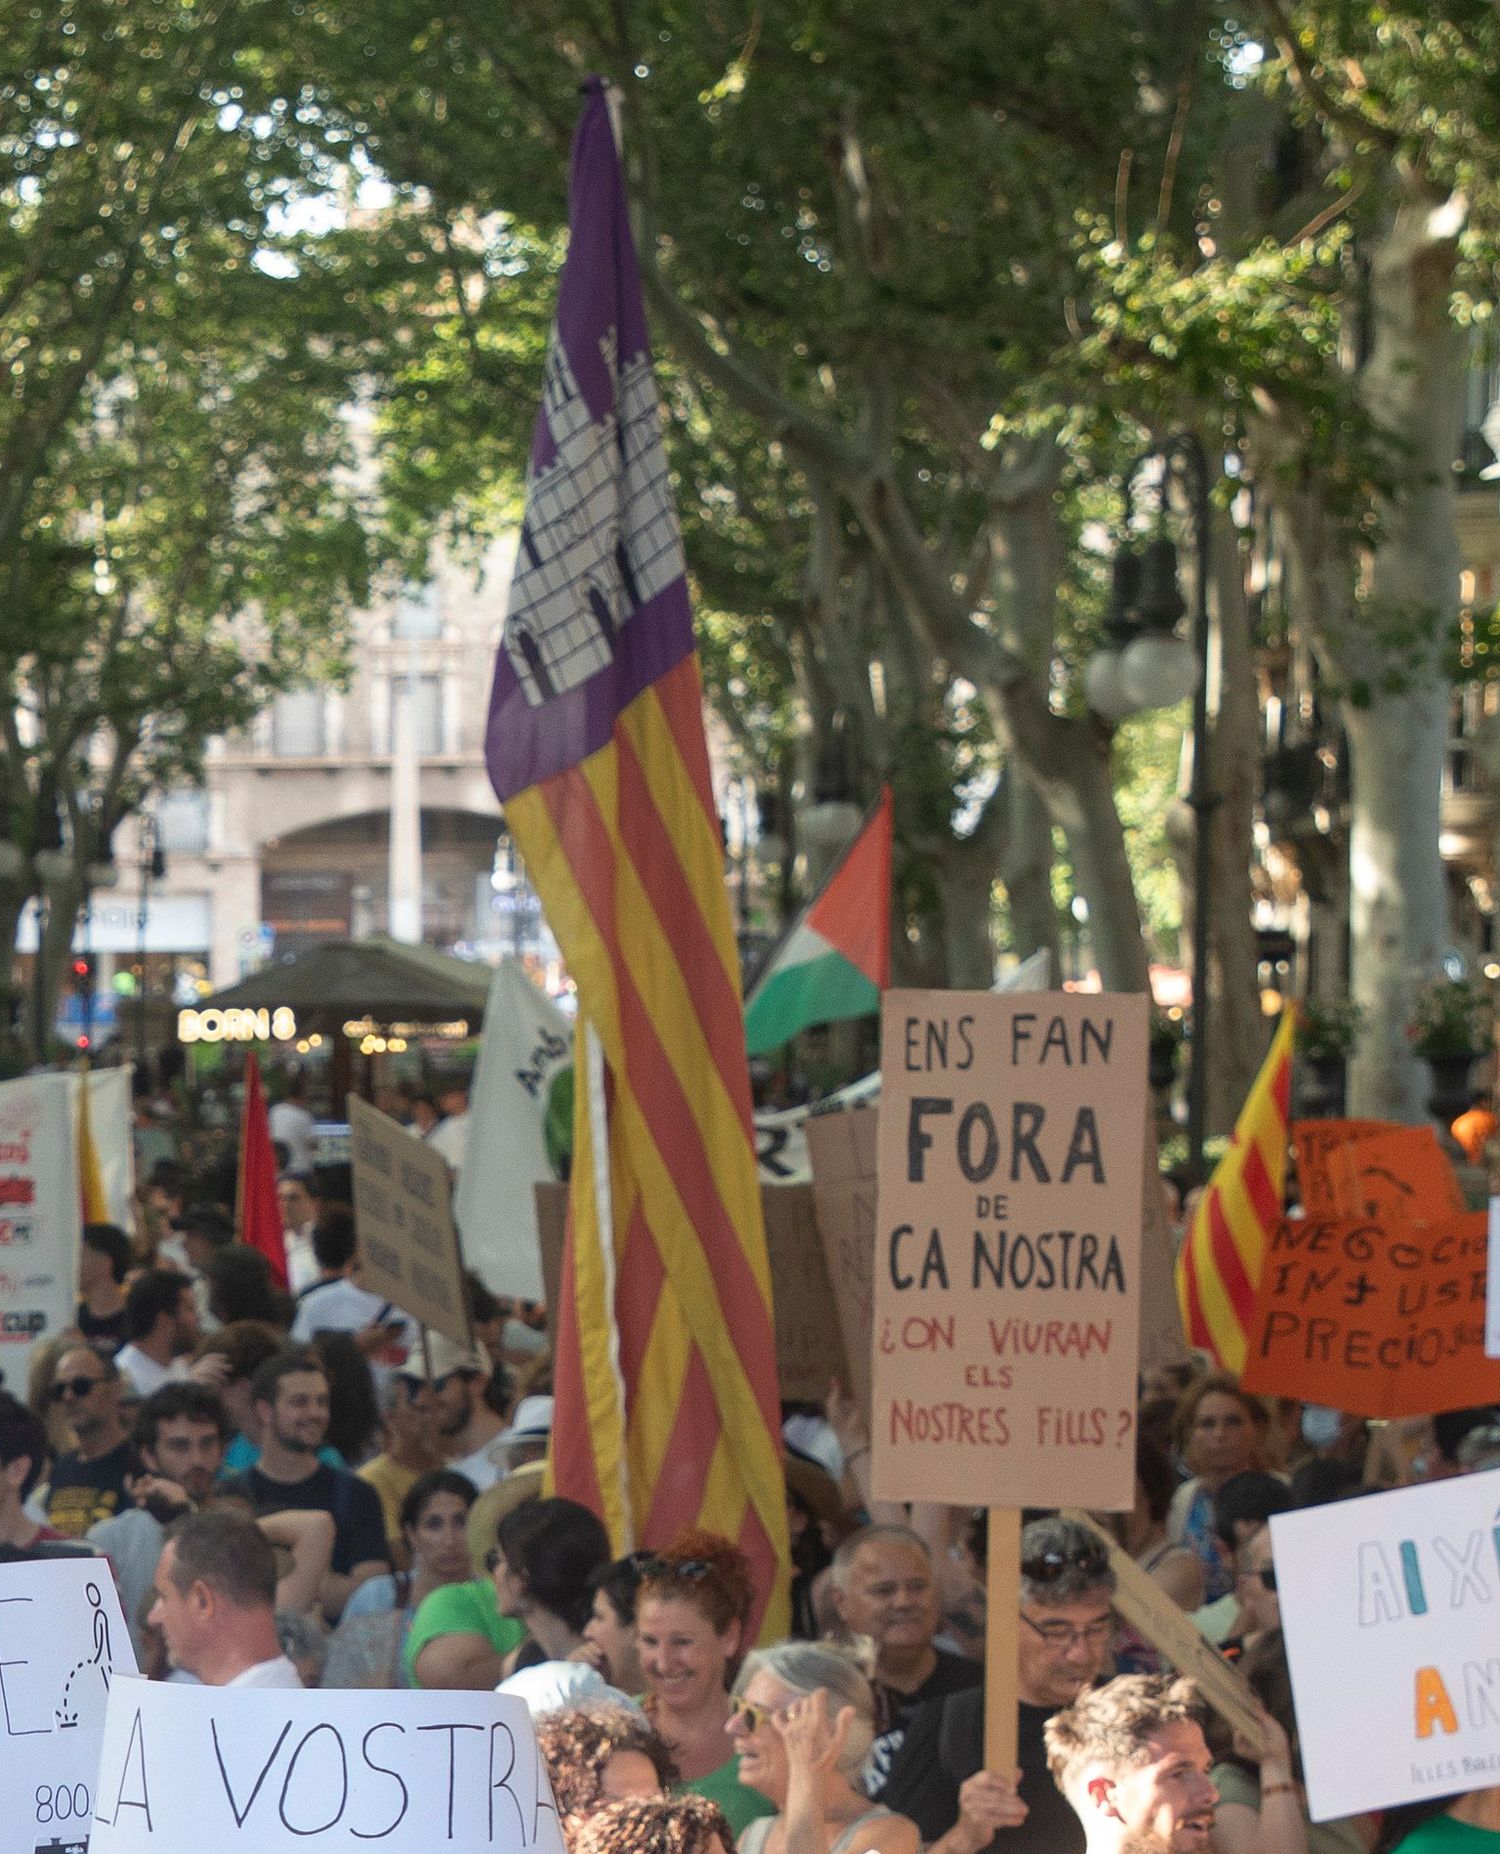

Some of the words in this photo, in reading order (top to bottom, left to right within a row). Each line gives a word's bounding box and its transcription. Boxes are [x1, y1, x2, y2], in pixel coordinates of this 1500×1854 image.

[178, 1008, 269, 1043] BORN
[272, 1006, 296, 1041] 8
[905, 1015, 974, 1072] ENS
[1011, 1014, 1114, 1066] FAN
[907, 1098, 1106, 1185] FORA
[976, 1195, 1009, 1220] DE
[889, 1224, 950, 1291] CA
[972, 1229, 1127, 1295] NOSTRA
[965, 1364, 1013, 1390] ELS
[889, 1399, 1011, 1447] NOSTRES
